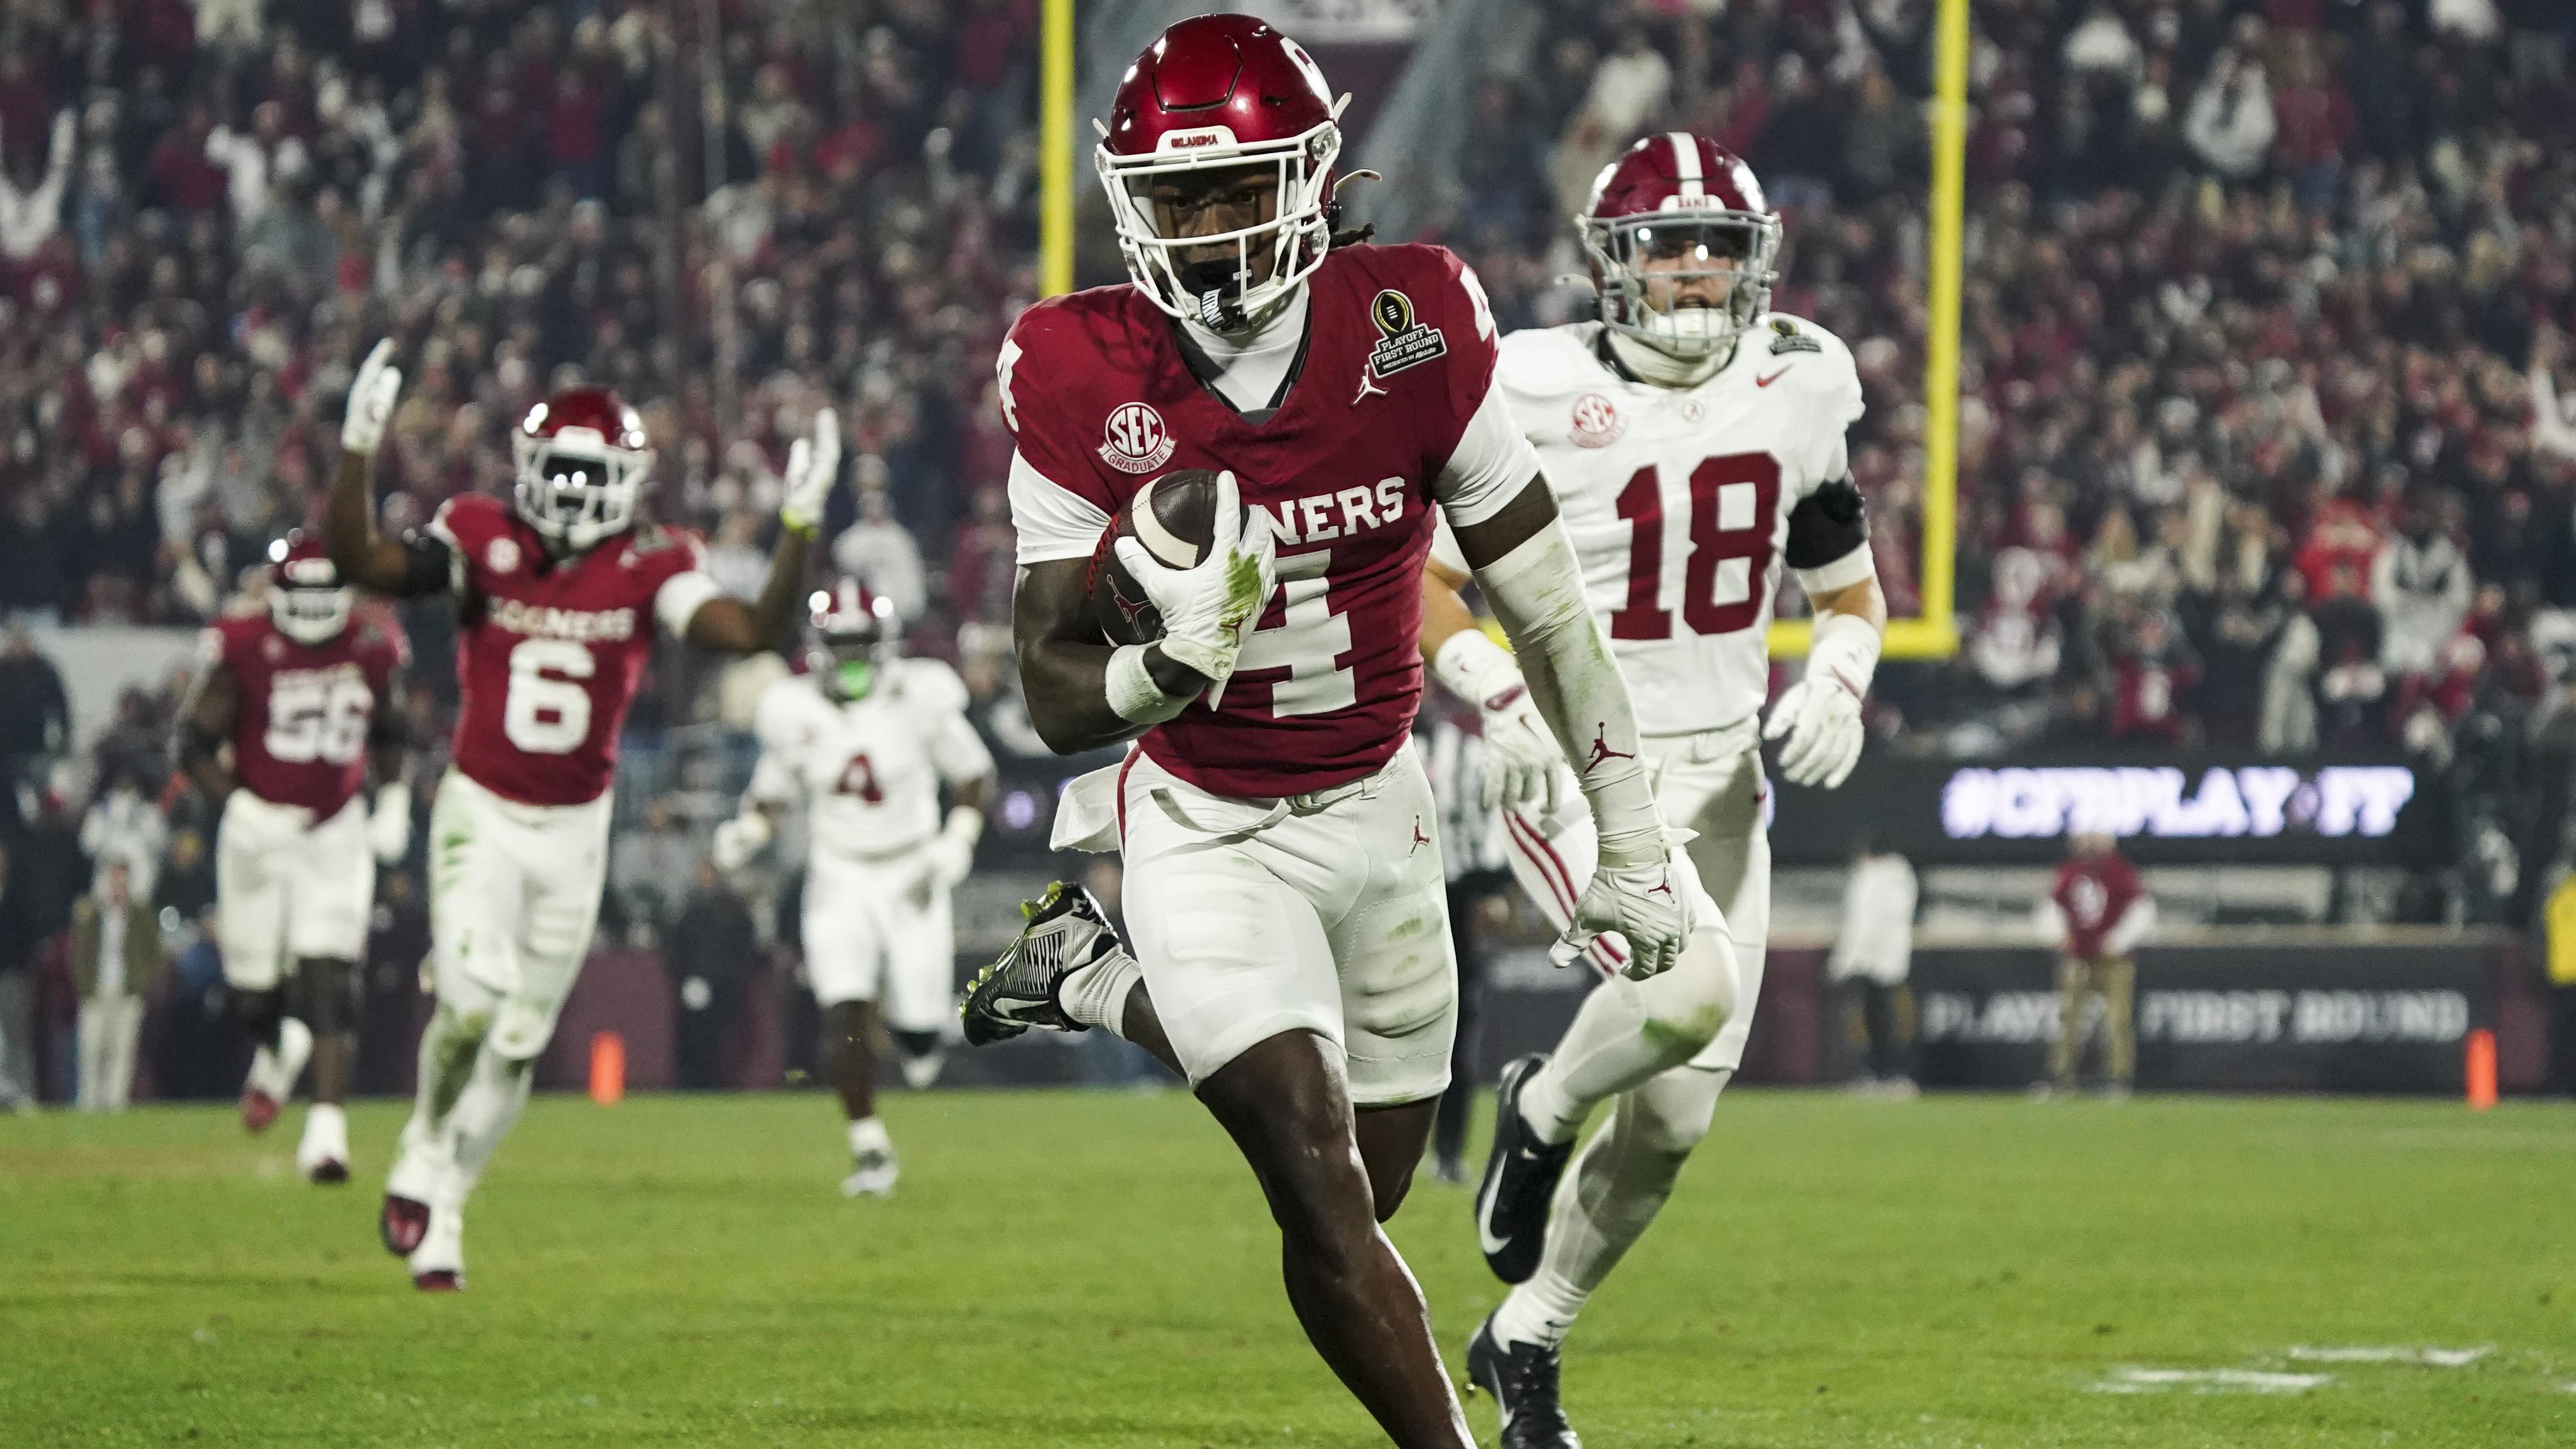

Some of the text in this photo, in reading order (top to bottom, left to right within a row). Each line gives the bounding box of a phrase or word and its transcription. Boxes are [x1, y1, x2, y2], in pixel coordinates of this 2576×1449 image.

[1171, 134, 1218, 148] OKLAHOMA
[1374, 334, 1439, 364] FIRST ROUND
[1381, 328, 1425, 351] PLAYOFF
[1383, 357, 1408, 370] PRESENTED
[1415, 347, 1437, 359] Allstate
[1110, 407, 1159, 456] SEC
[1576, 397, 1616, 433] SEC
[1109, 451, 1168, 472] GRADUATE
[1257, 476, 1405, 546] NERS
[1611, 451, 1782, 640] 18
[1233, 548, 1356, 719] 4
[504, 637, 596, 755] 6
[2139, 989, 2291, 1043] FIRST
[2296, 989, 2468, 1043] ROUND
